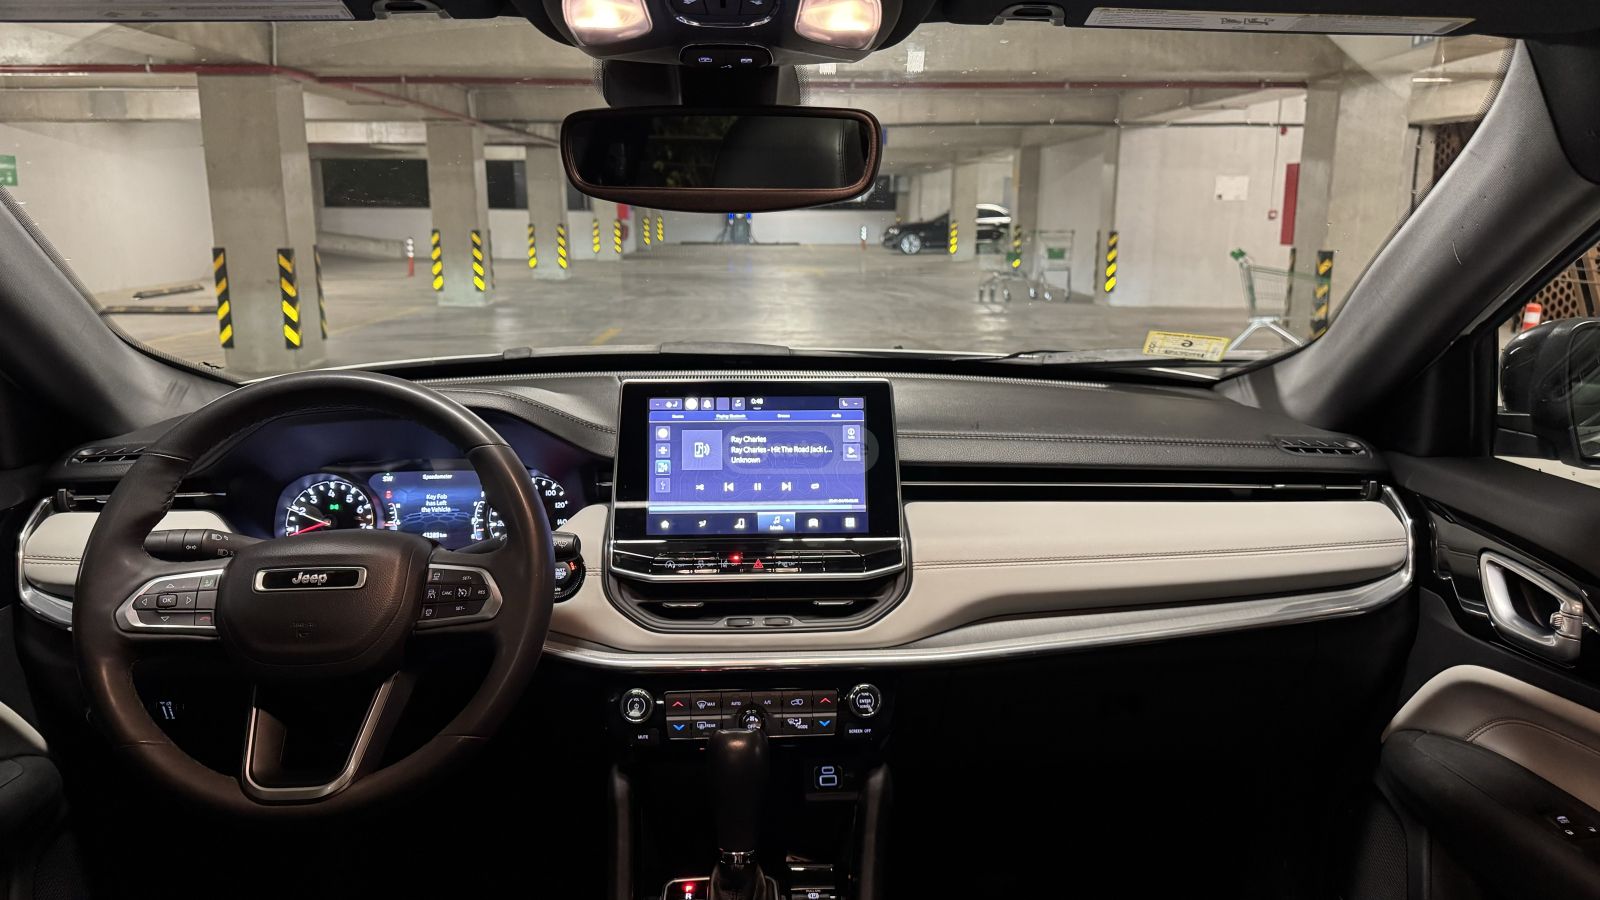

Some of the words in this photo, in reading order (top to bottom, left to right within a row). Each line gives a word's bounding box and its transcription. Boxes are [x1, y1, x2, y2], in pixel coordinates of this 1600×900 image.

[731, 436, 743, 444] Ray
[743, 435, 767, 443] Charles
[731, 446, 743, 454] Ray
[794, 445, 809, 453] Road
[810, 445, 824, 454] Jack
[731, 456, 761, 464] Unknown
[327, 489, 336, 498] 4
[545, 489, 557, 497] 100
[310, 495, 318, 504] 3
[345, 494, 354, 503] 5
[356, 505, 364, 514] 6
[555, 501, 566, 509] 120
[300, 507, 306, 516] 2
[292, 572, 327, 585] Jeep
